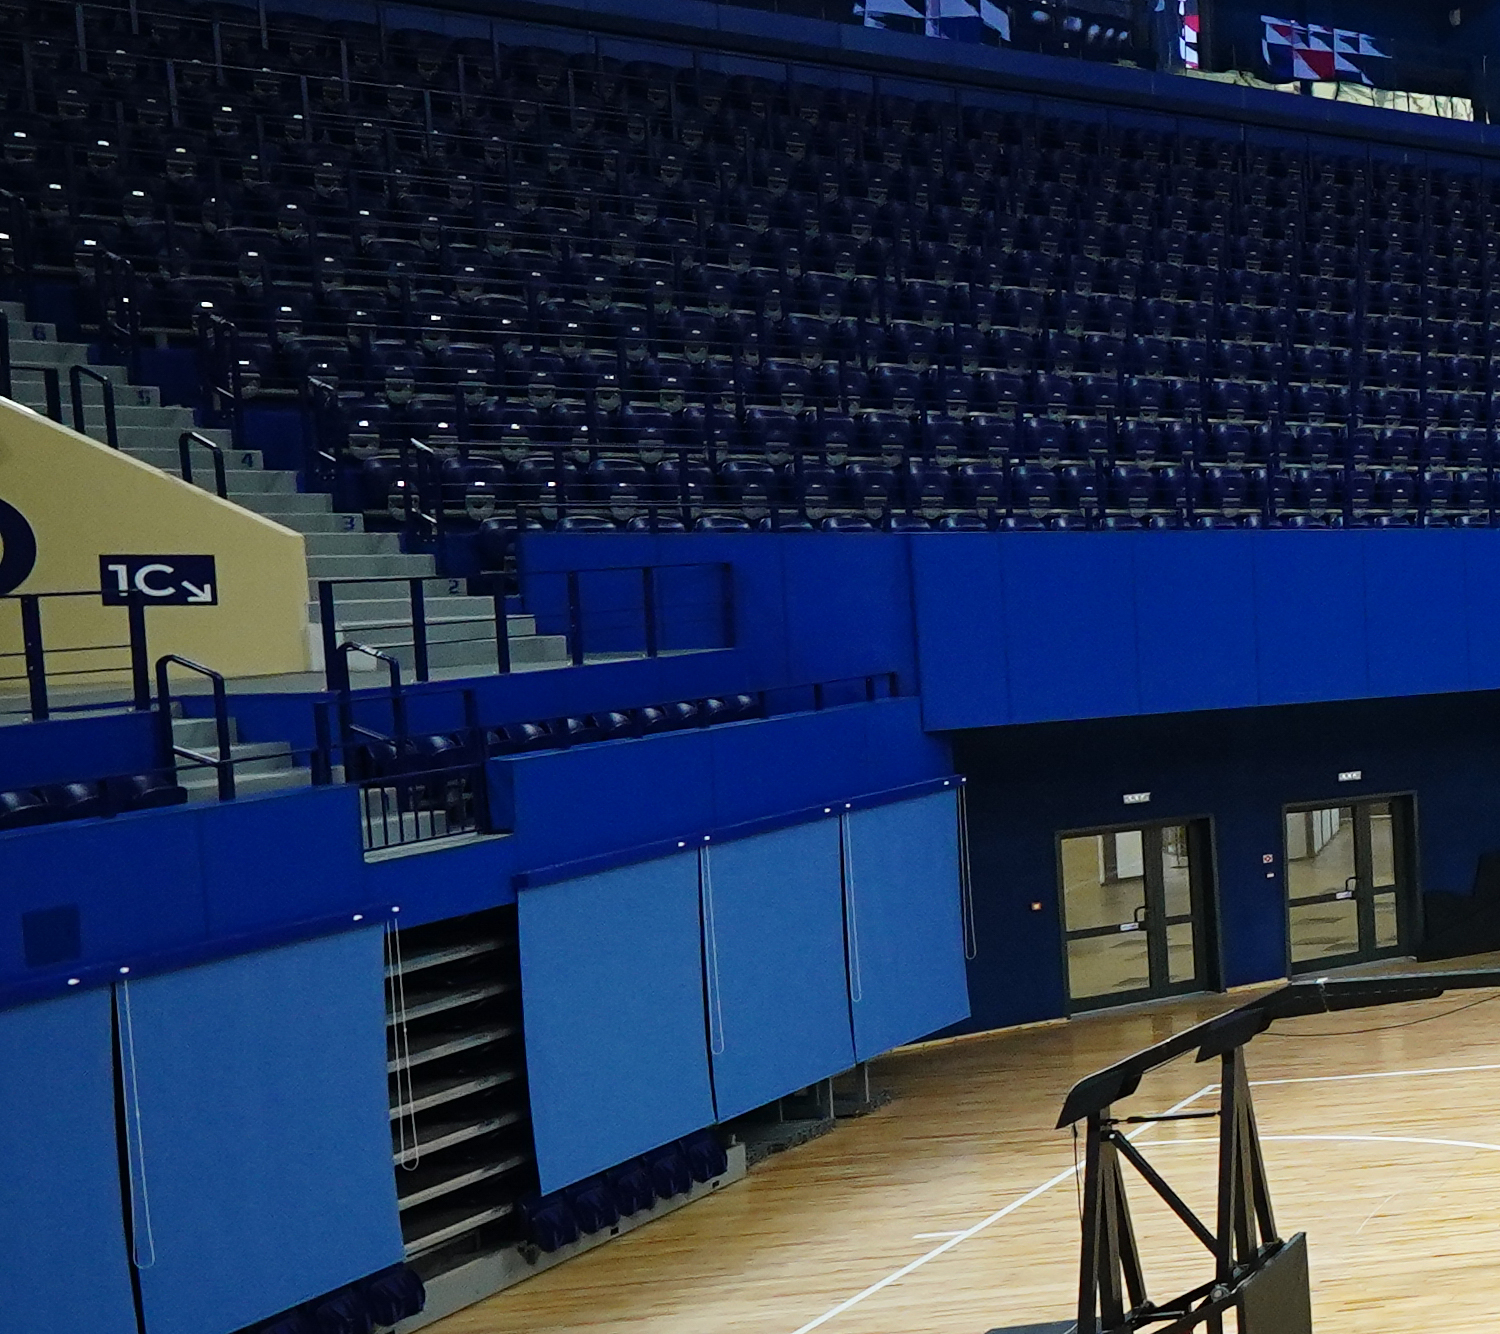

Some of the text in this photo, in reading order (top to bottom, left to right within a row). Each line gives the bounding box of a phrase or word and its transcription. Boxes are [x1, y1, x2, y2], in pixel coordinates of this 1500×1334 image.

[241, 452, 253, 467] 4
[343, 516, 355, 530] 3
[108, 562, 175, 597] 1C
[449, 580, 459, 594] 2
